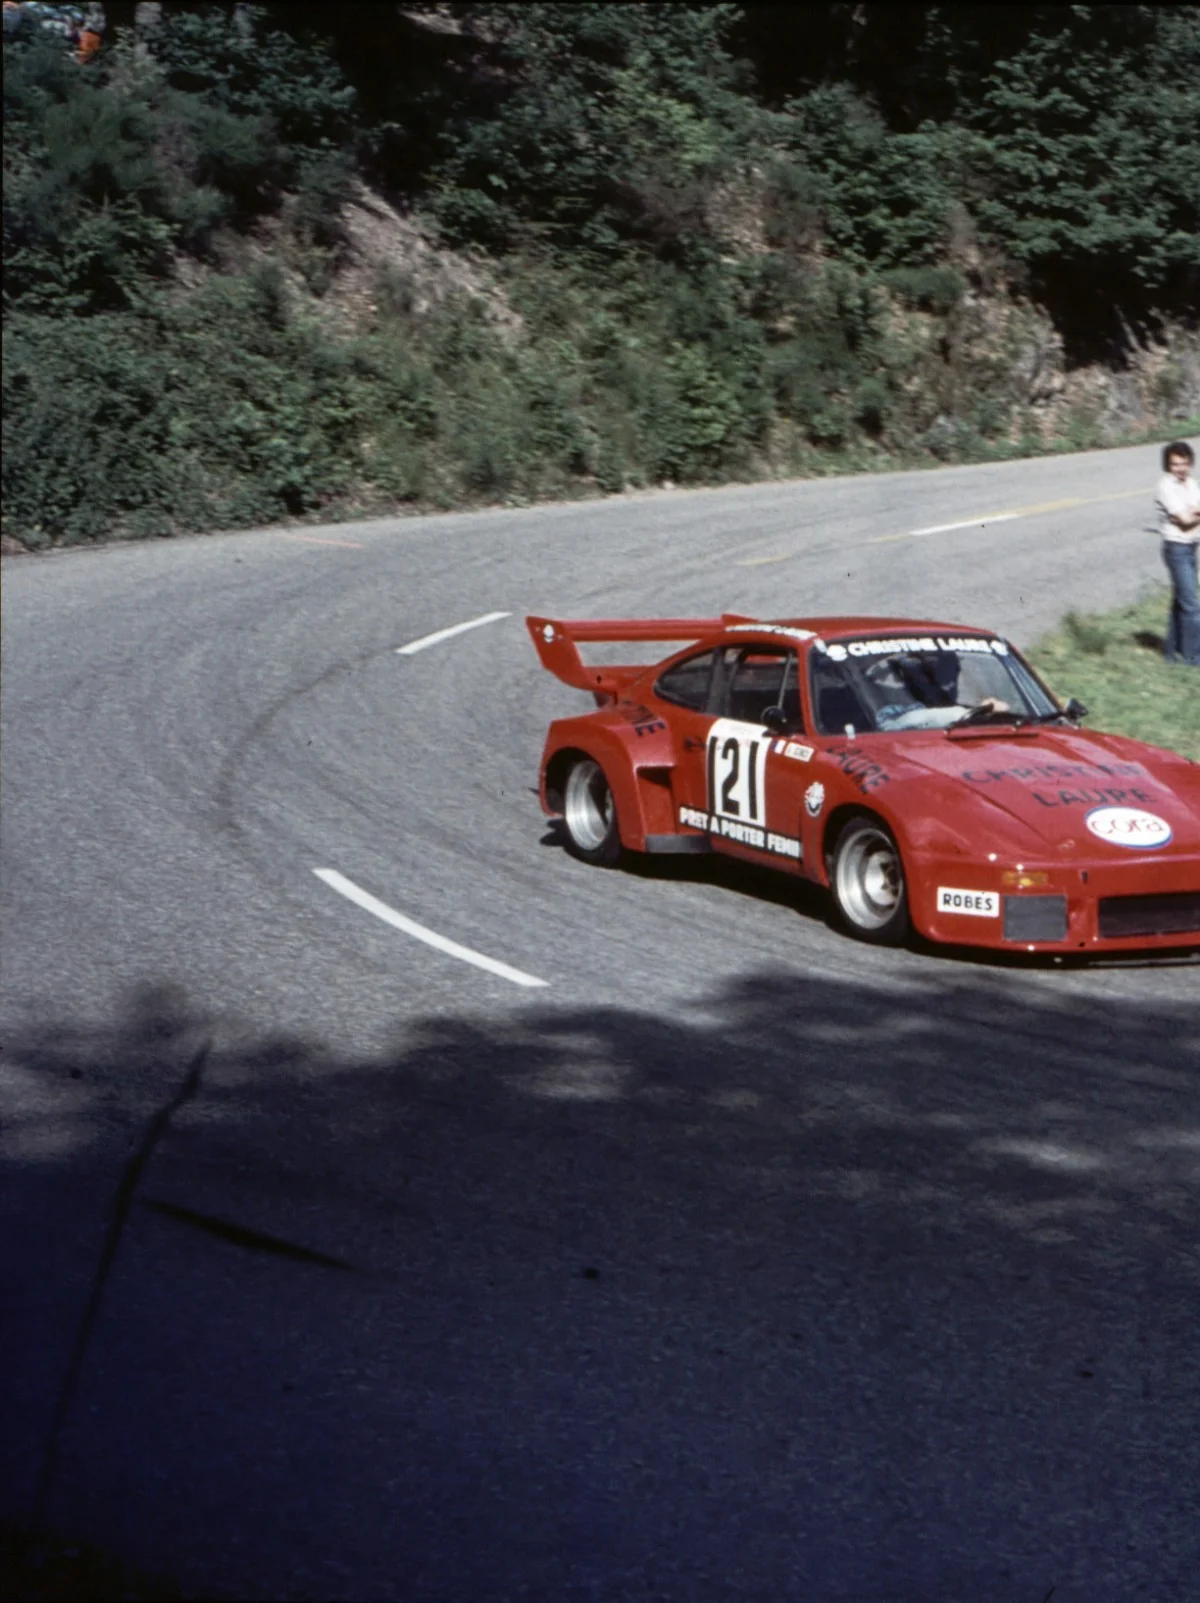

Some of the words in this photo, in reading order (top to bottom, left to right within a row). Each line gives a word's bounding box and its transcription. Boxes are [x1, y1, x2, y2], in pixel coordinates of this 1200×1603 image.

[708, 736, 760, 820] 121
[1031, 788, 1157, 807] LAURE
[680, 806, 708, 831] PRET
[710, 815, 720, 834] A
[721, 819, 765, 849] PORTER
[942, 892, 993, 911] ROBES
